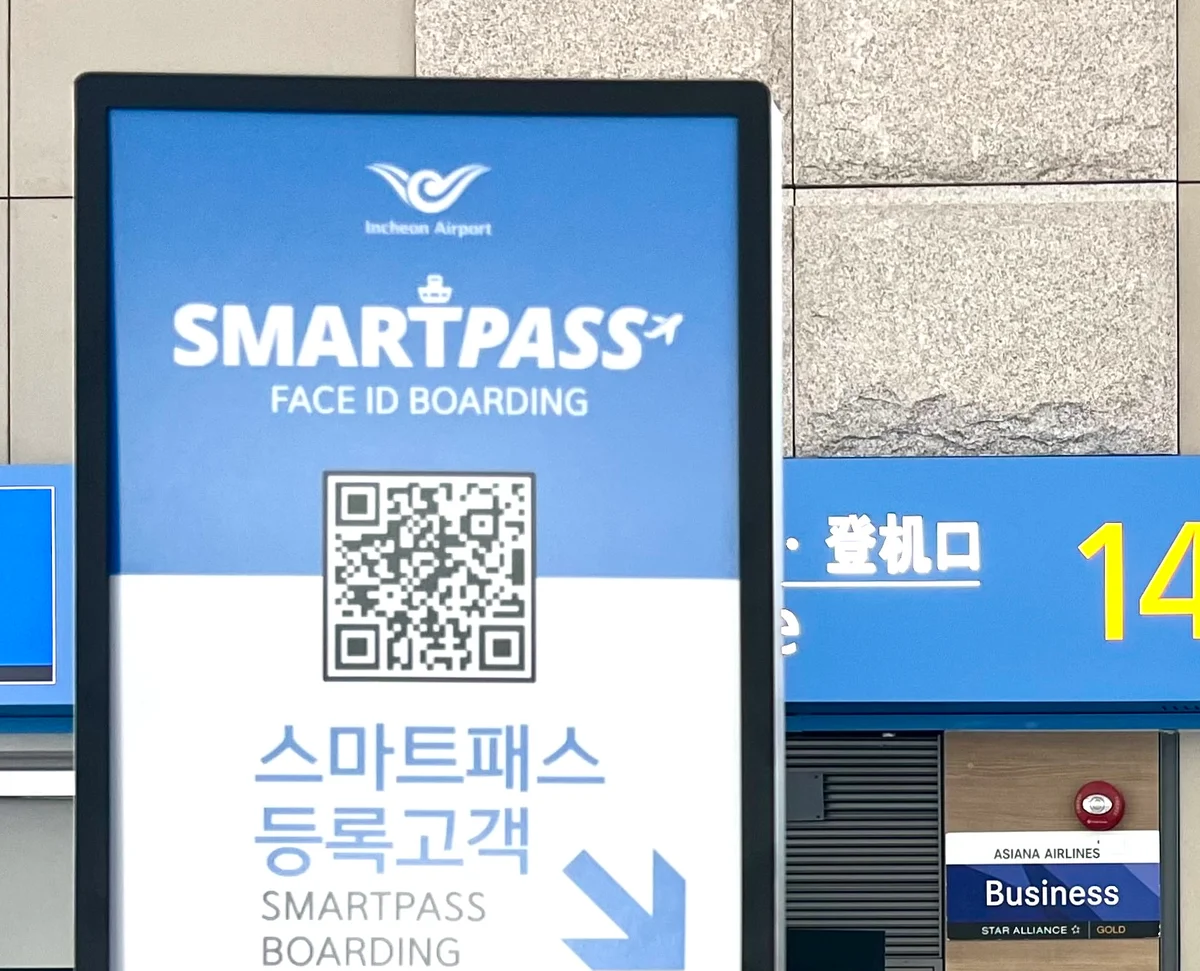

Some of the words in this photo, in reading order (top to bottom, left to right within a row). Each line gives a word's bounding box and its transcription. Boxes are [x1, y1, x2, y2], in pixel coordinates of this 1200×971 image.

[365, 220, 429, 236] Incheon
[434, 221, 493, 238] Airport
[172, 303, 650, 371] SMARTPASS
[270, 385, 356, 414] FACE
[366, 386, 399, 415] ID
[410, 386, 589, 417] BOARDING
[824, 512, 981, 575] 登机口
[254, 722, 606, 792] 스마트패스
[254, 806, 529, 877] 등록고객
[994, 848, 1040, 860] ASIANA
[1044, 847, 1101, 860] AIRLINES
[262, 890, 486, 922] SMARTPASS
[985, 879, 1120, 907] Business
[981, 926, 1010, 935] STAR
[1013, 925, 1068, 935] ALLIANCE
[1096, 925, 1126, 934] GOLD
[262, 936, 460, 967] BOARDING
